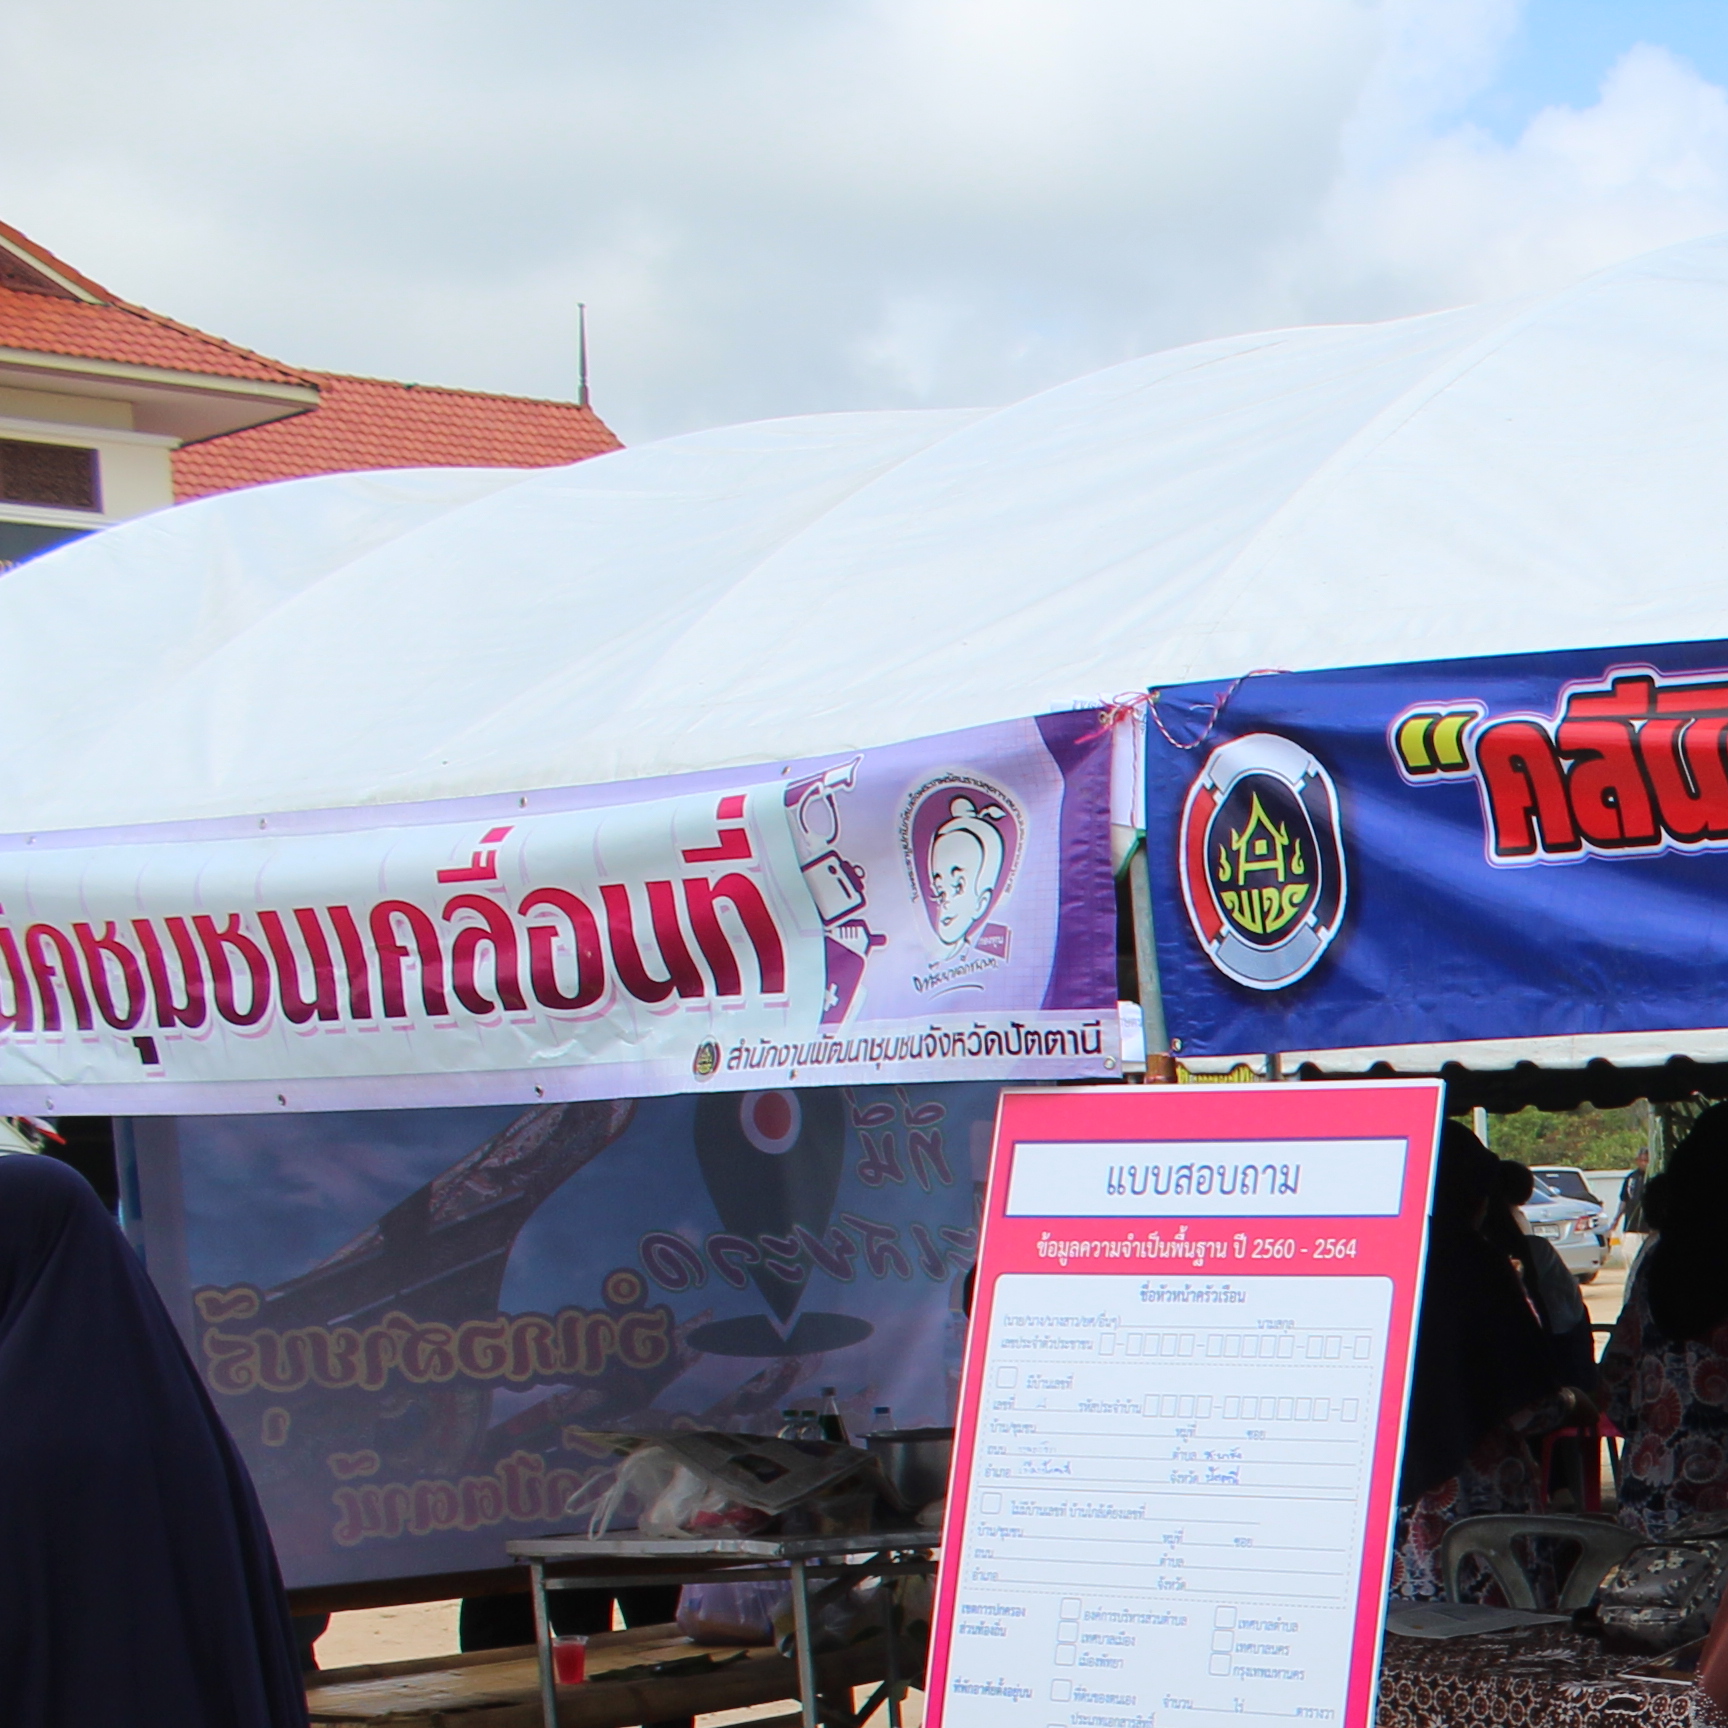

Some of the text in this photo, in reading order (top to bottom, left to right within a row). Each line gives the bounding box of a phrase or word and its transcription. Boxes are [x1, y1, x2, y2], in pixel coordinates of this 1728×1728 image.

[727, 1020, 1101, 1071] สำนักงานพัฒนาชุมชนจังหวัดปัตตานี
[1106, 1162, 1300, 1195] แบบสอบถาม
[1035, 1224, 1357, 1267] ข้อมูลความจำเป็นพื้นฐาน ปี 2560 2564
